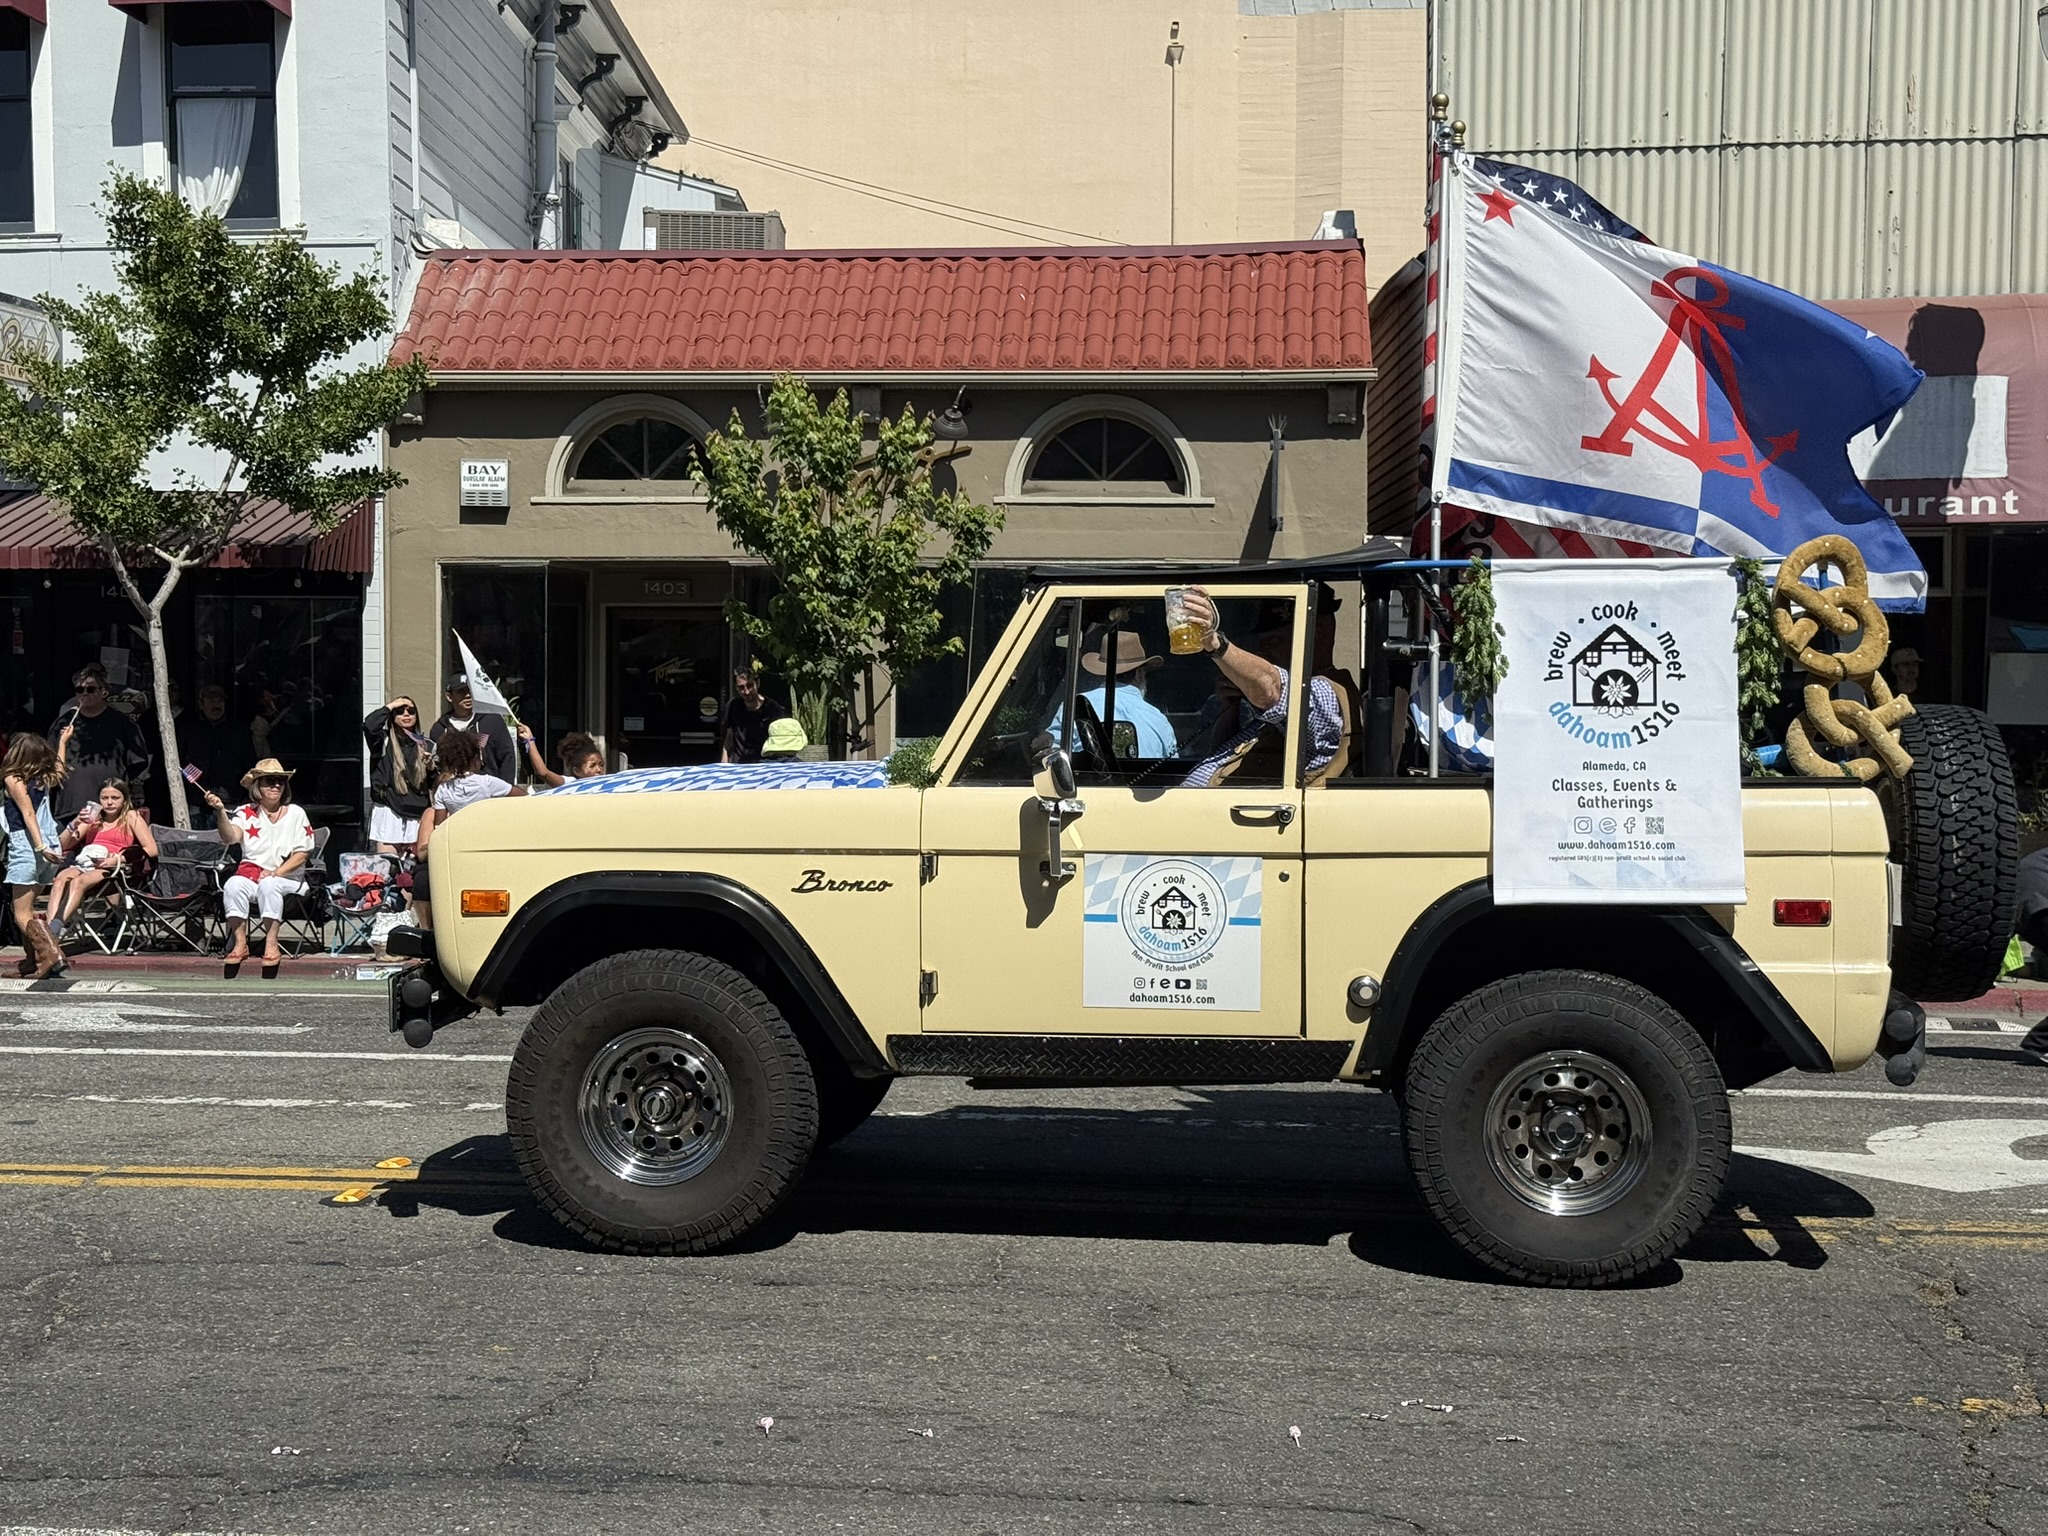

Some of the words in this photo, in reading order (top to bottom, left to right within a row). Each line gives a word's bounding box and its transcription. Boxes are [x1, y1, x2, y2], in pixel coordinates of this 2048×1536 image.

[468, 465, 501, 475] BAY
[1883, 489, 2020, 517] urant
[100, 585, 129, 598] 140
[644, 582, 688, 595] 1403
[1543, 631, 1572, 682] brew
[1591, 600, 1639, 621] cook
[1657, 631, 1687, 682] meet
[1582, 761, 1630, 772] Alameda,
[1633, 761, 1647, 771] CA
[1552, 778, 1608, 793] Classes,
[1613, 779, 1661, 792] Events
[1665, 779, 1678, 792] &
[1577, 795, 1654, 812] Gatherings
[1557, 840, 1676, 850] www.dahoam1516.com
[1548, 855, 1576, 863] registered
[791, 869, 894, 894] Bronco
[1135, 890, 1150, 915] brew
[1163, 874, 1186, 885] cook
[1197, 892, 1211, 917] meet
[1165, 963, 1187, 972] School
[1188, 959, 1201, 970] and
[1202, 952, 1215, 964] Club
[1129, 992, 1216, 1004] dahoam1516.com
